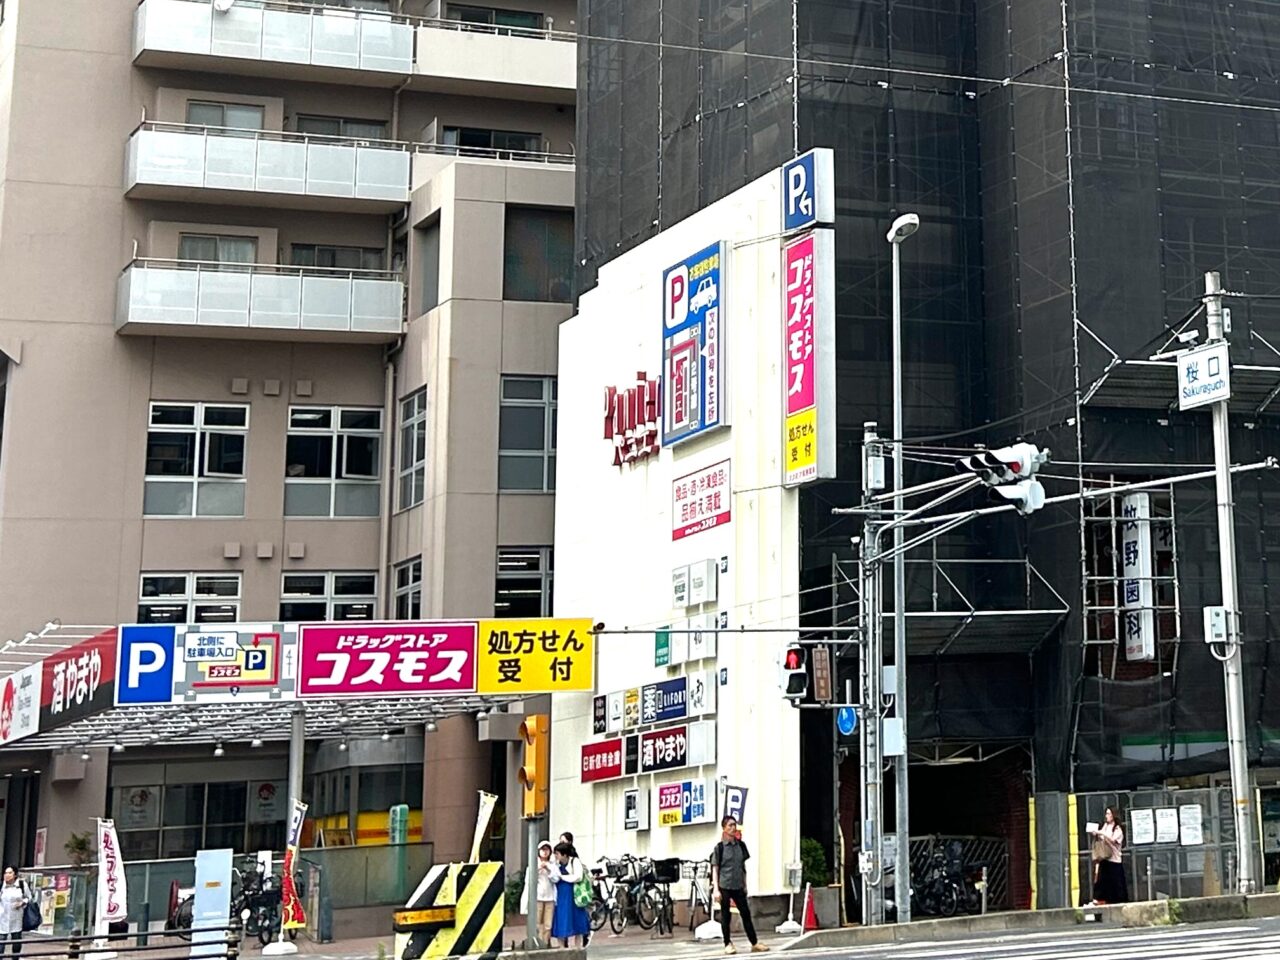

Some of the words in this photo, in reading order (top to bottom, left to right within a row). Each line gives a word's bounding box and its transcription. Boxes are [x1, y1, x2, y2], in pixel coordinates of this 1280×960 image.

[788, 162, 807, 216] P
[670, 274, 684, 320] P
[802, 253, 815, 361] ドラッグストア
[787, 257, 806, 396] コスモス
[1186, 356, 1220, 385] 桜口
[187, 647, 235, 659] 駐車場入口
[197, 636, 226, 647] 北側に
[335, 632, 448, 650] ドラッグストア
[487, 630, 585, 656] 処方せん
[127, 642, 166, 688] P
[209, 668, 241, 678] コスモス
[248, 650, 263, 670] P
[307, 649, 470, 688] コスモス
[51, 647, 102, 716] 酒やまや
[582, 750, 621, 772] 日新信用金庫
[642, 734, 686, 767] 酒やまや
[660, 793, 681, 808] コスモス
[683, 791, 691, 816] P
